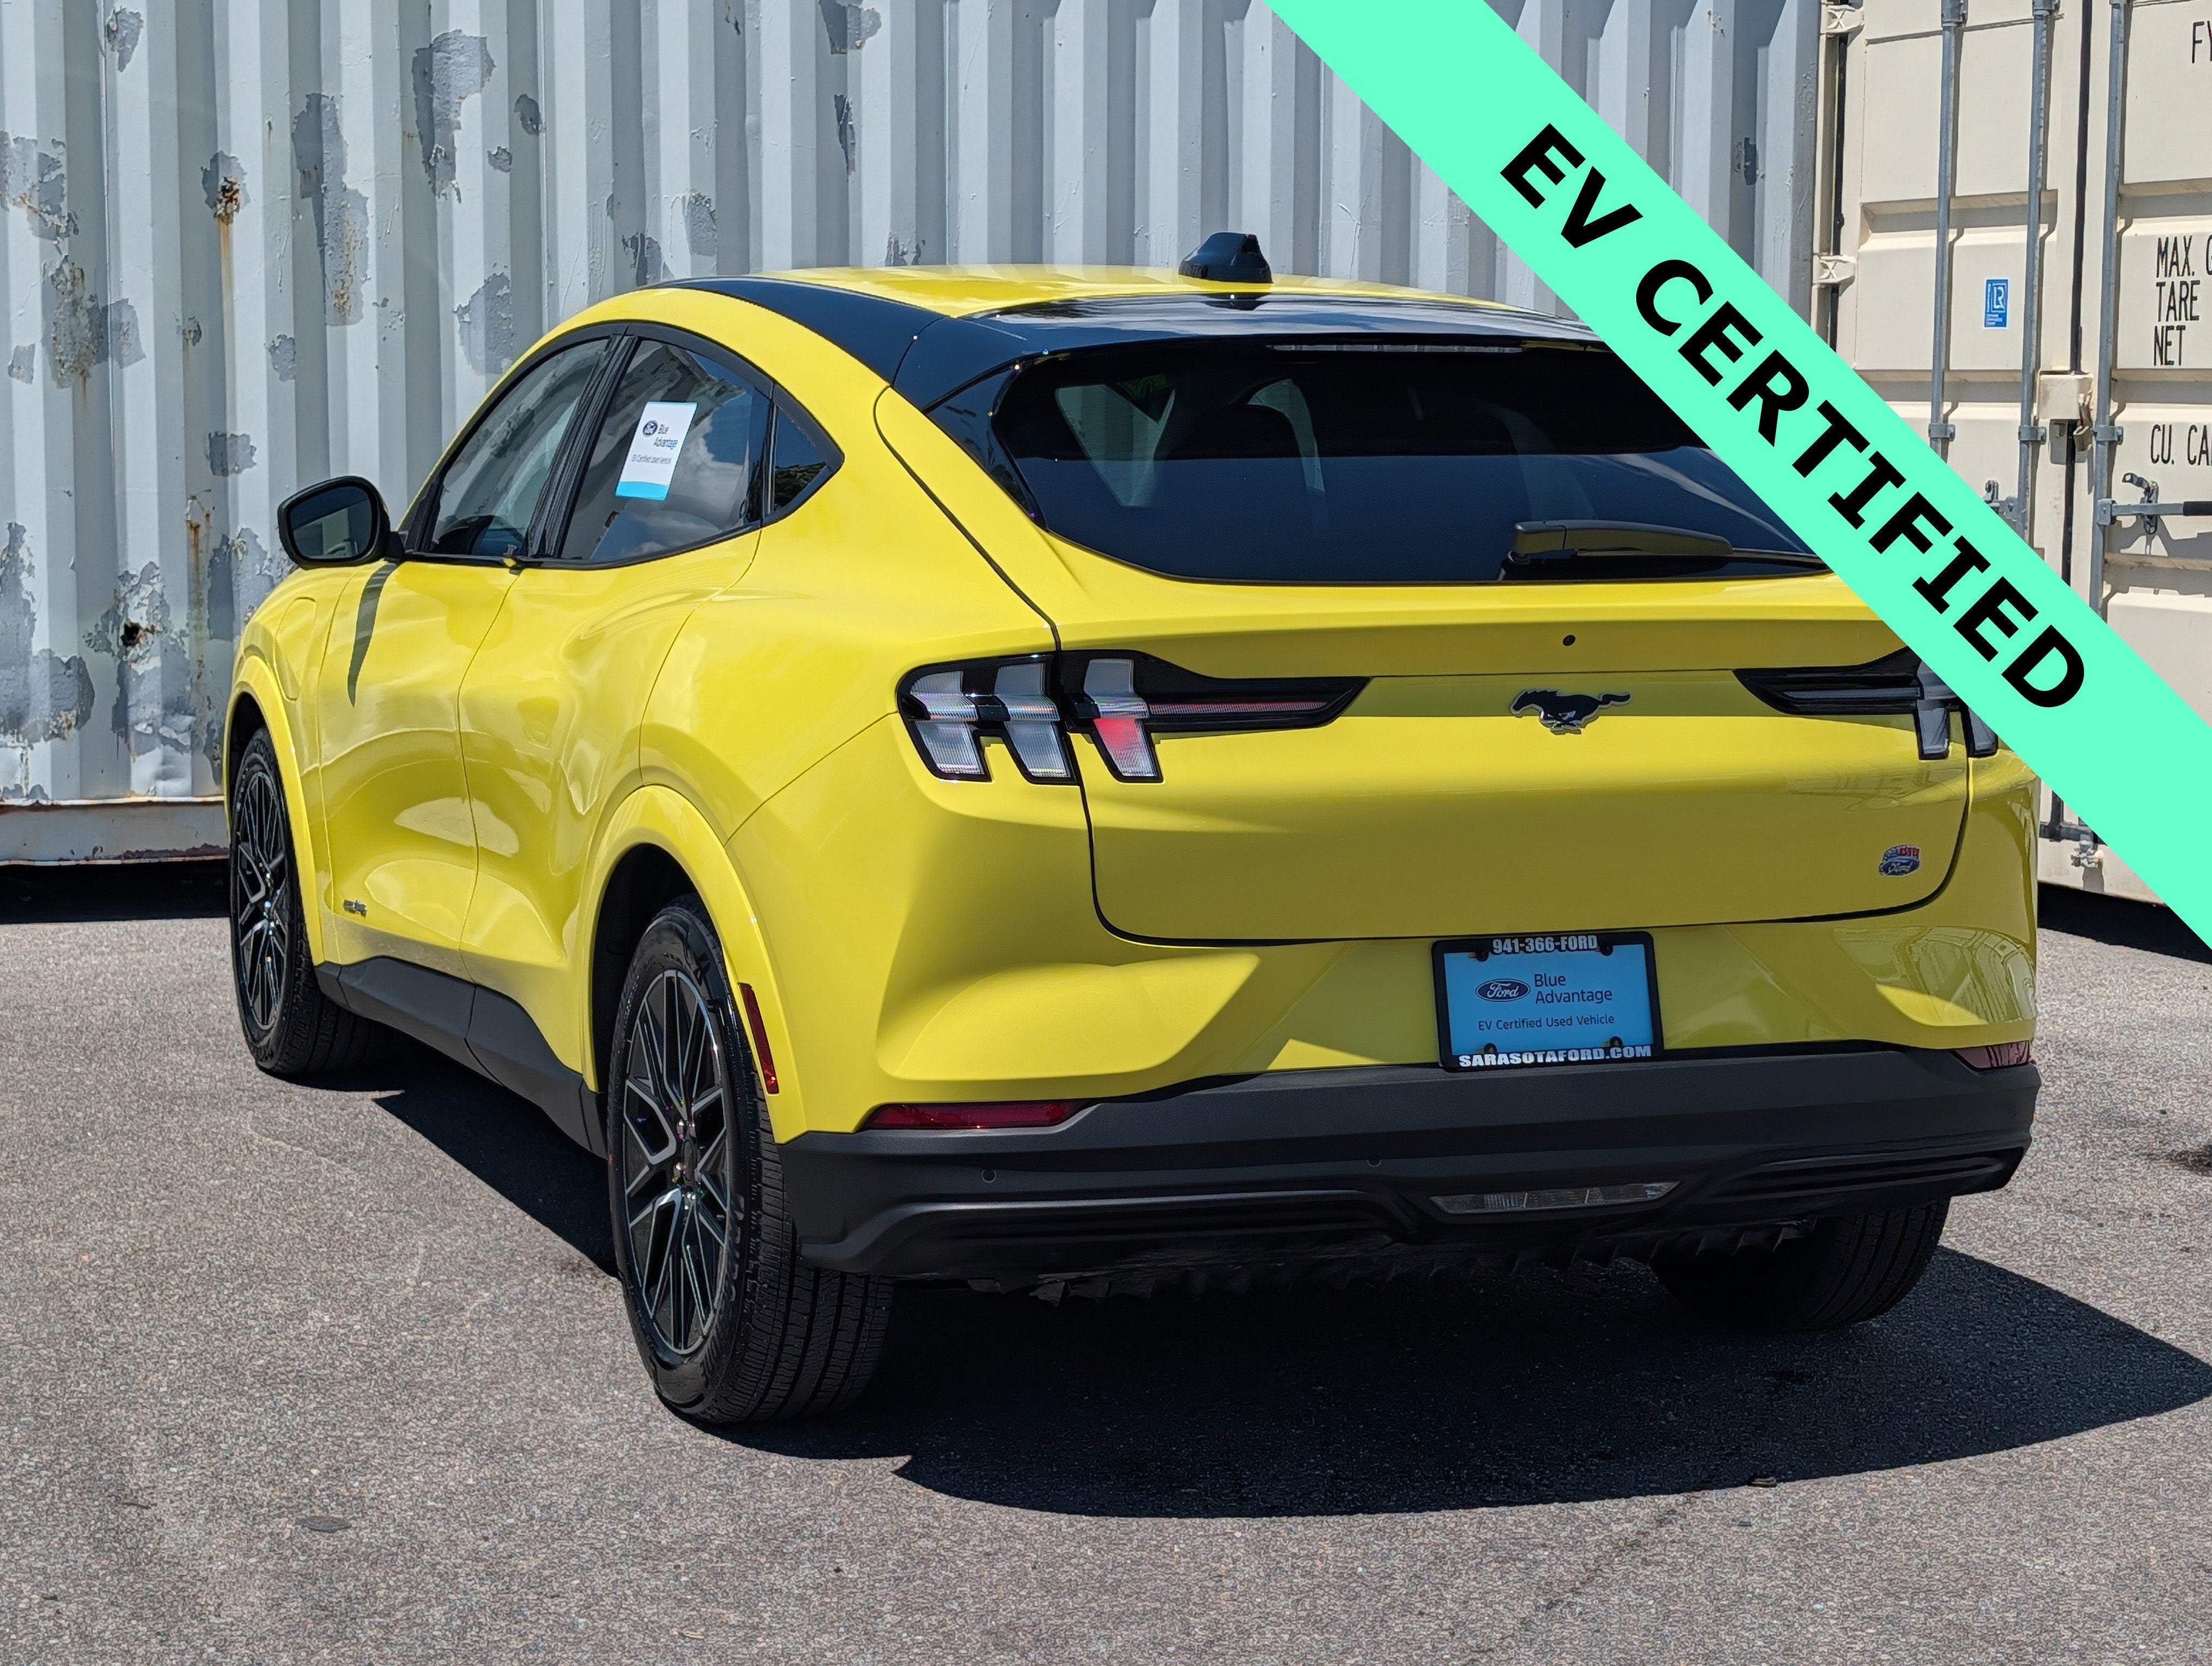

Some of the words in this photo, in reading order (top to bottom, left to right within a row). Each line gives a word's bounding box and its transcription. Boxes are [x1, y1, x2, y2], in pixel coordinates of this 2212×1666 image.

[2156, 235, 2195, 278] MAX.
[2156, 280, 2200, 322] TARE
[2153, 325, 2186, 366] NET
[2151, 424, 2175, 465] CU.
[2187, 424, 2212, 466] CA
[1493, 935, 1598, 953] 941-366-FORD
[1487, 982, 1519, 997] Ford
[1534, 973, 1566, 987] Blue
[1535, 990, 1612, 1004] Advantage
[1478, 1021, 1492, 1030] EV
[1496, 1018, 1542, 1029] Certified
[1546, 1016, 1573, 1027] Used
[1577, 1014, 1615, 1025] Vehicle
[1459, 1046, 1651, 1067] SARASOTAFORD.COM
